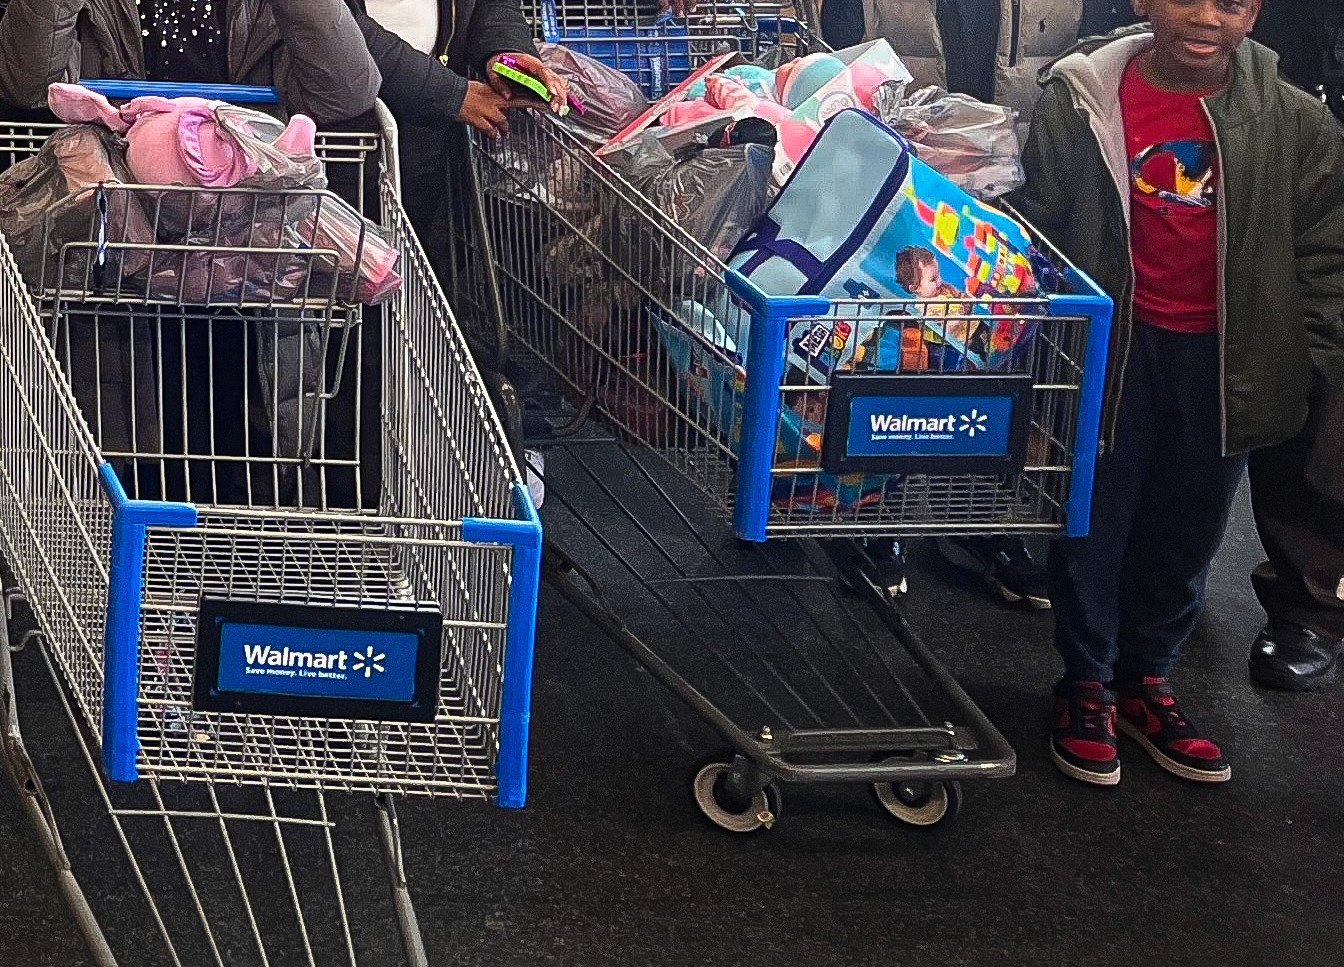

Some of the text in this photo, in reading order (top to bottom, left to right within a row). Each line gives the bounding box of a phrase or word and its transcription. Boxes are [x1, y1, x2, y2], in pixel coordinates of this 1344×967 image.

[870, 414, 956, 432] Walmart
[244, 644, 347, 669] Walmart
[245, 666, 348, 680] Save money. Live better.
